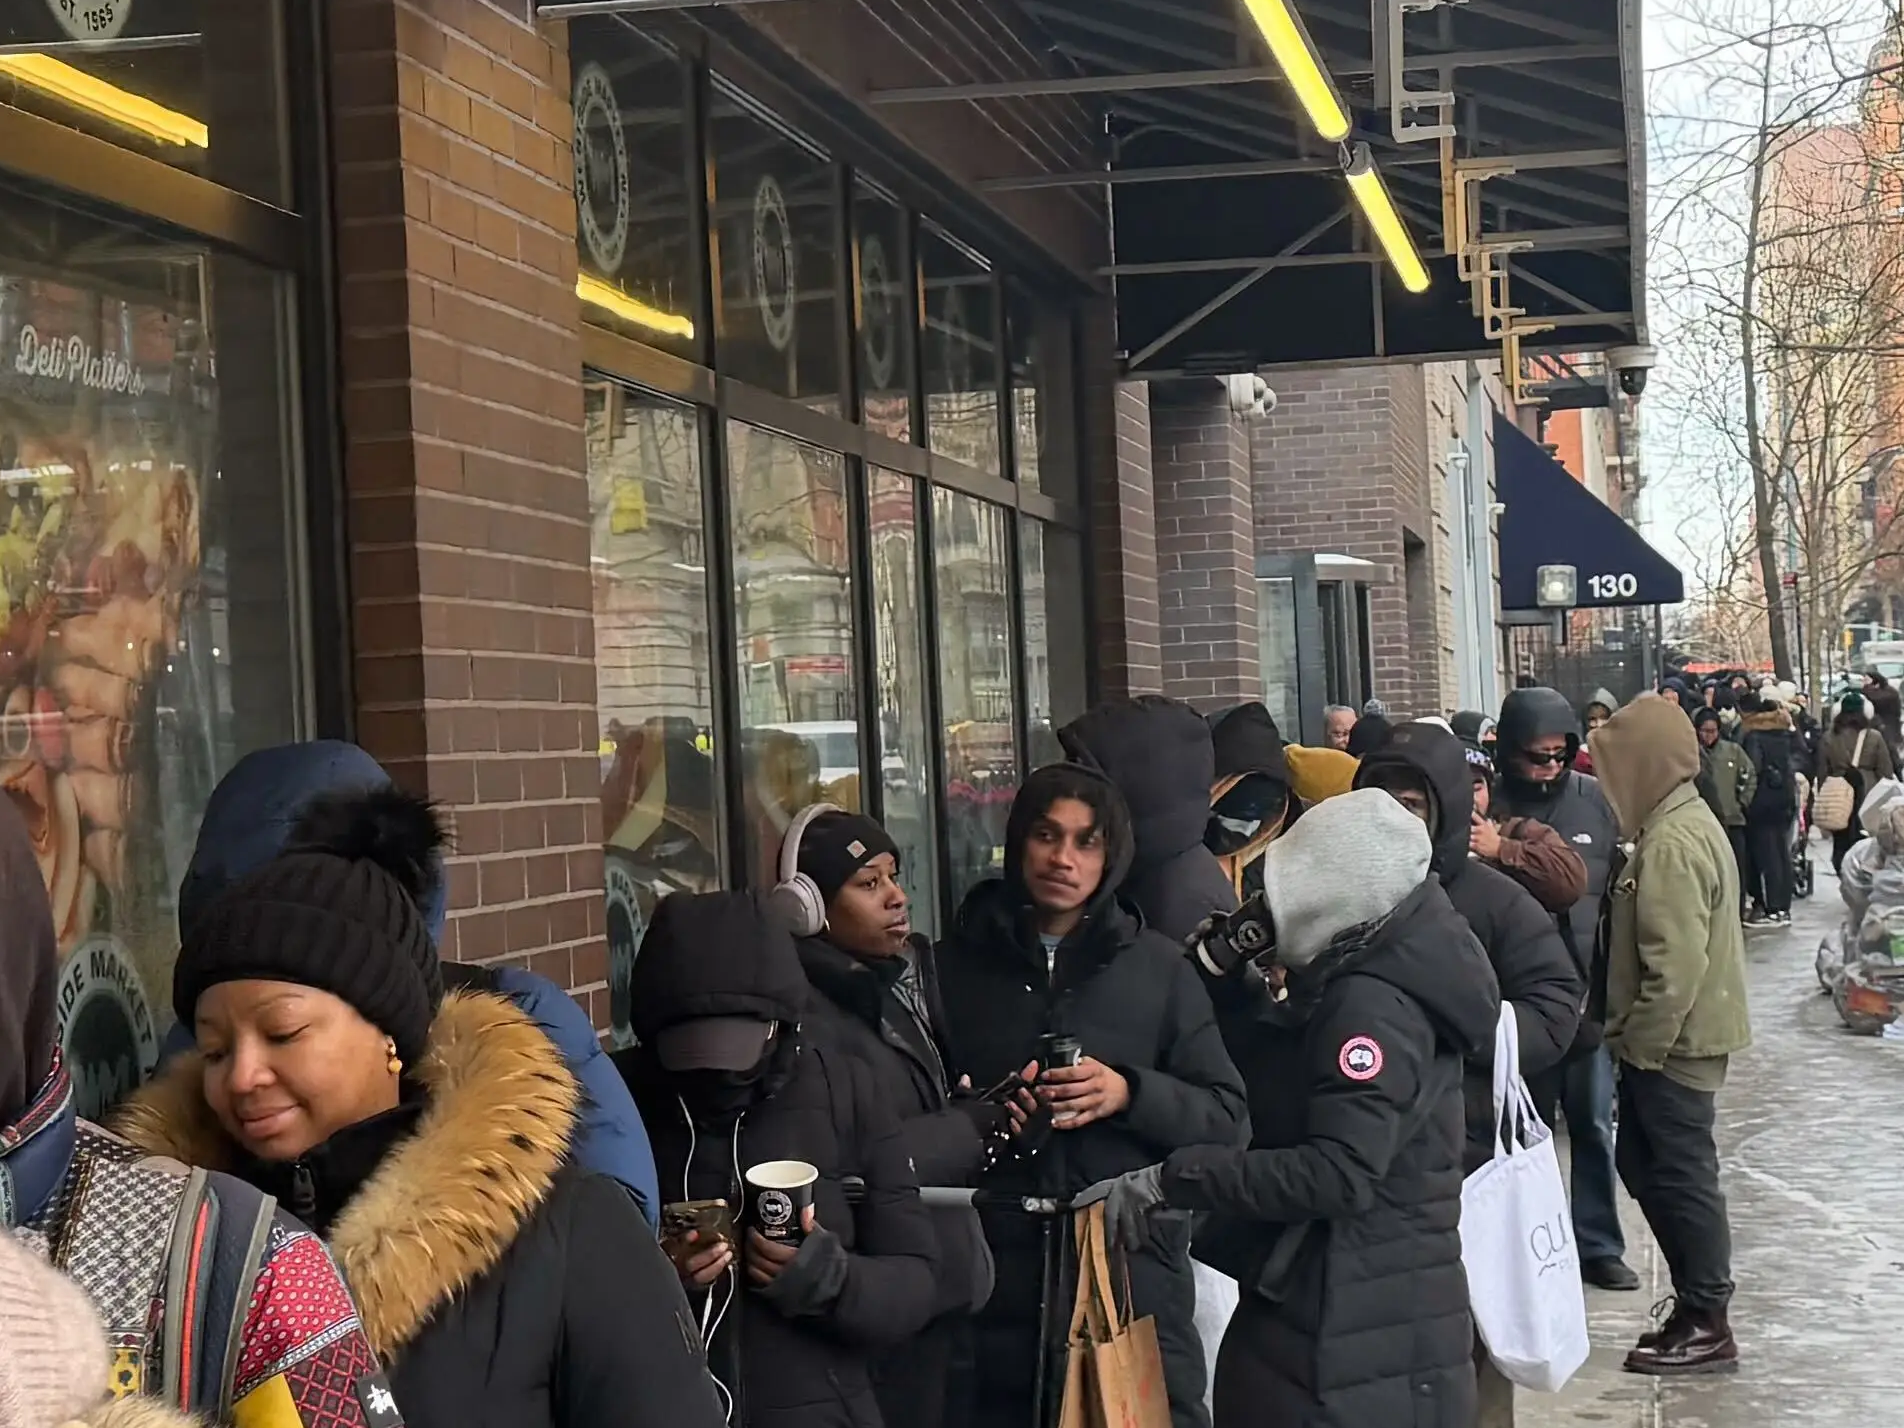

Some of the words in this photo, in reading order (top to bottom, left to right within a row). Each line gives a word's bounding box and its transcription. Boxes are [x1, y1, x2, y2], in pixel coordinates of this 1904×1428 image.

[15, 324, 65, 379] Deli
[67, 334, 146, 398] Platters
[1588, 573, 1637, 598] 130
